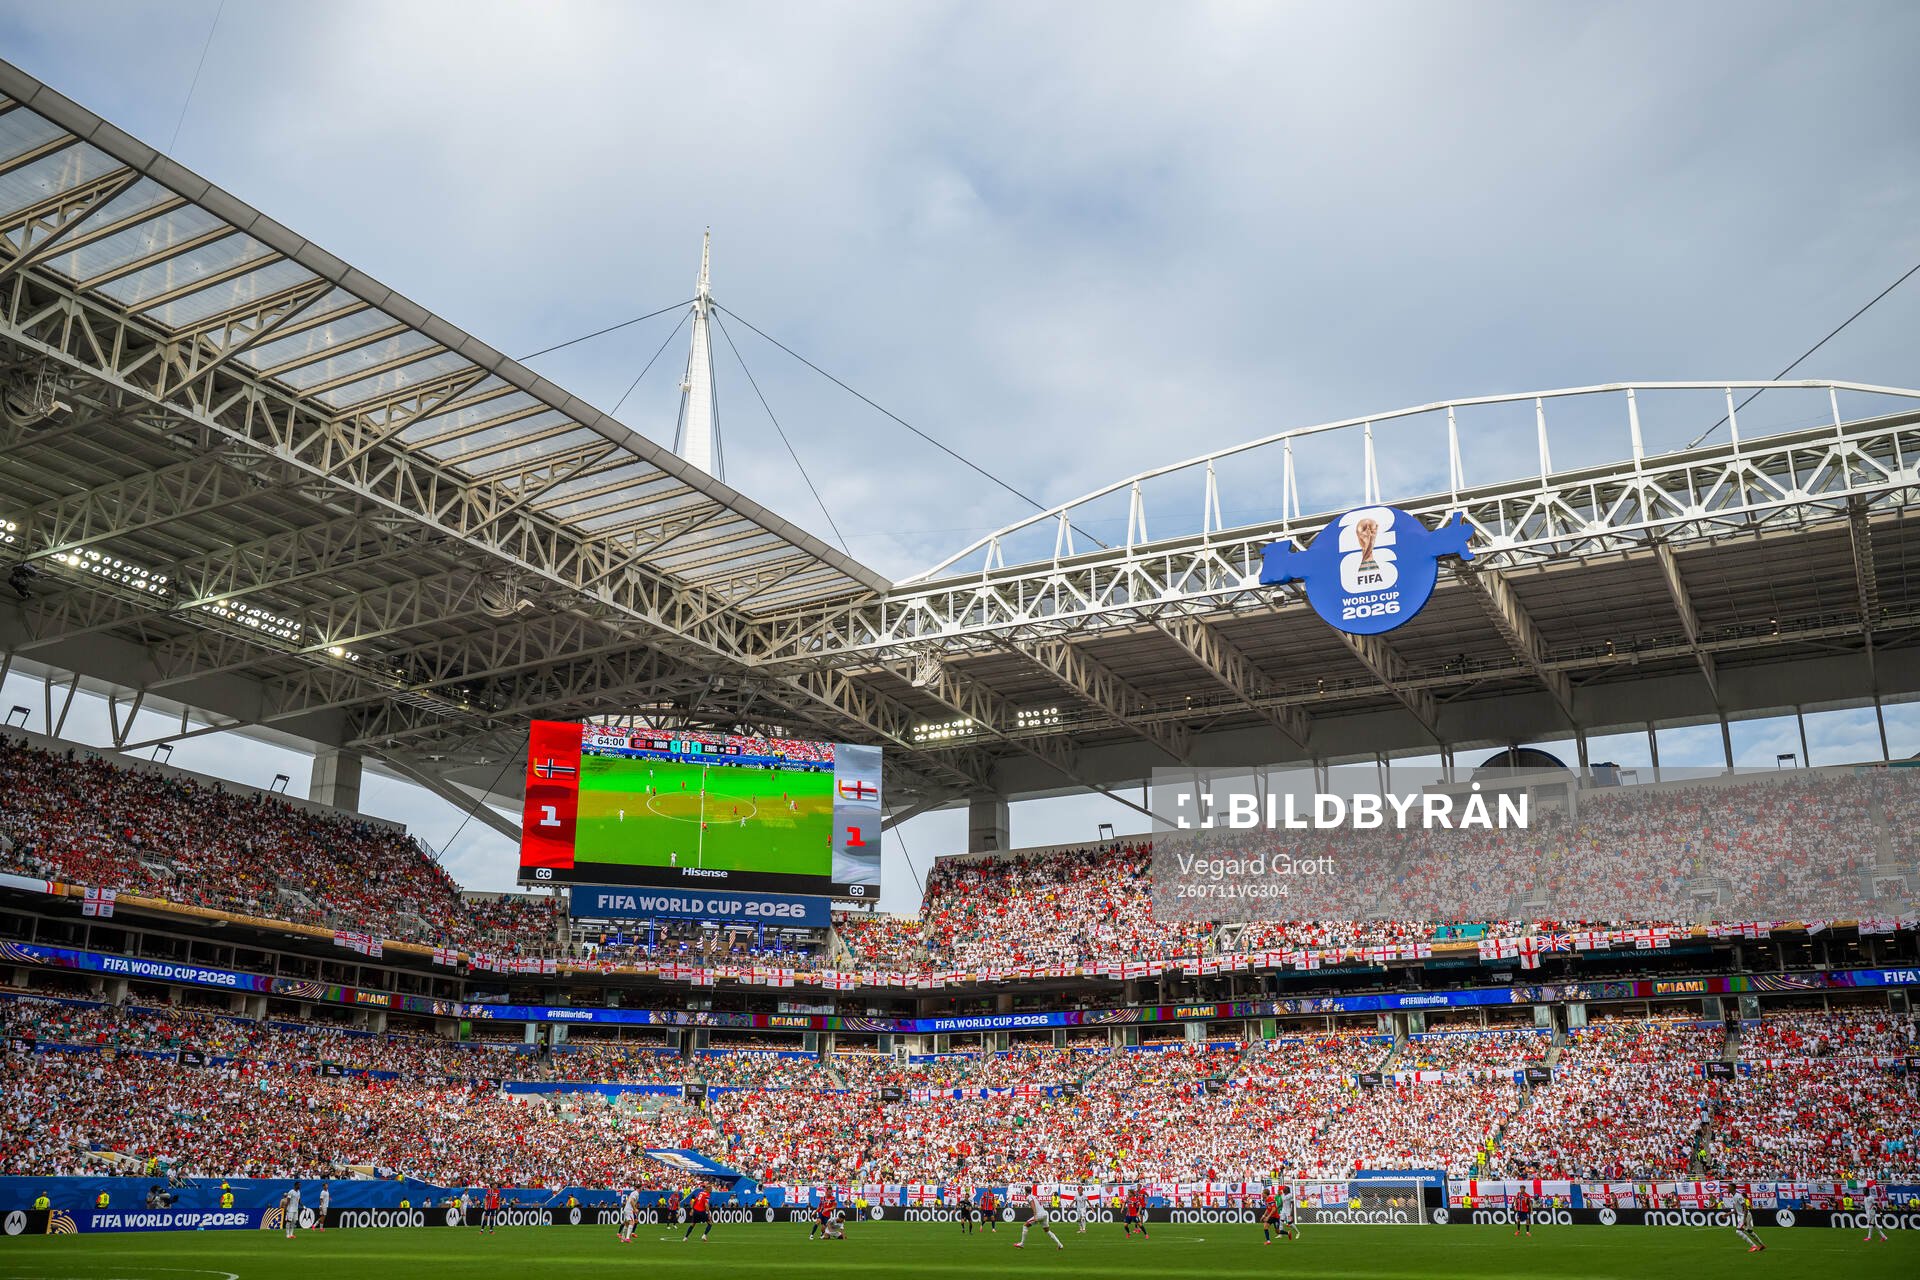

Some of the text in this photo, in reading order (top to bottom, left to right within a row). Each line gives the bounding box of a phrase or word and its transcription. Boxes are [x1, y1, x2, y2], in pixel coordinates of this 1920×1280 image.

[1357, 574, 1383, 586] FIFA
[1342, 592, 1400, 607] WORLD CUP
[1342, 601, 1401, 621] 2026
[597, 736, 625, 747] 64:00
[539, 805, 561, 826] 1
[846, 826, 867, 847] 1
[537, 869, 551, 879] CC
[682, 867, 728, 879] Hisense
[851, 886, 863, 895] CC
[597, 894, 806, 918] FIFA WORLD CUP 2026
[103, 958, 236, 986] FIFA WORLD CUP 2026
[1883, 970, 1917, 983] FIFA
[1656, 980, 1705, 993] MIAMI
[357, 992, 389, 1006] MIAMI
[1400, 996, 1448, 1006] #FIFAWorldCup
[547, 1010, 594, 1021] #FIFAWorldCup
[1176, 1006, 1215, 1017] MIAMI
[771, 1016, 809, 1027] MIAMI
[935, 1014, 1049, 1030] FIFA WORLD CUP 2026
[91, 1212, 246, 1229] FIFA WORLD CUP 2026
[339, 1207, 425, 1229] motorola
[1170, 1207, 1256, 1224] motorola
[1315, 1207, 1408, 1225] motorola
